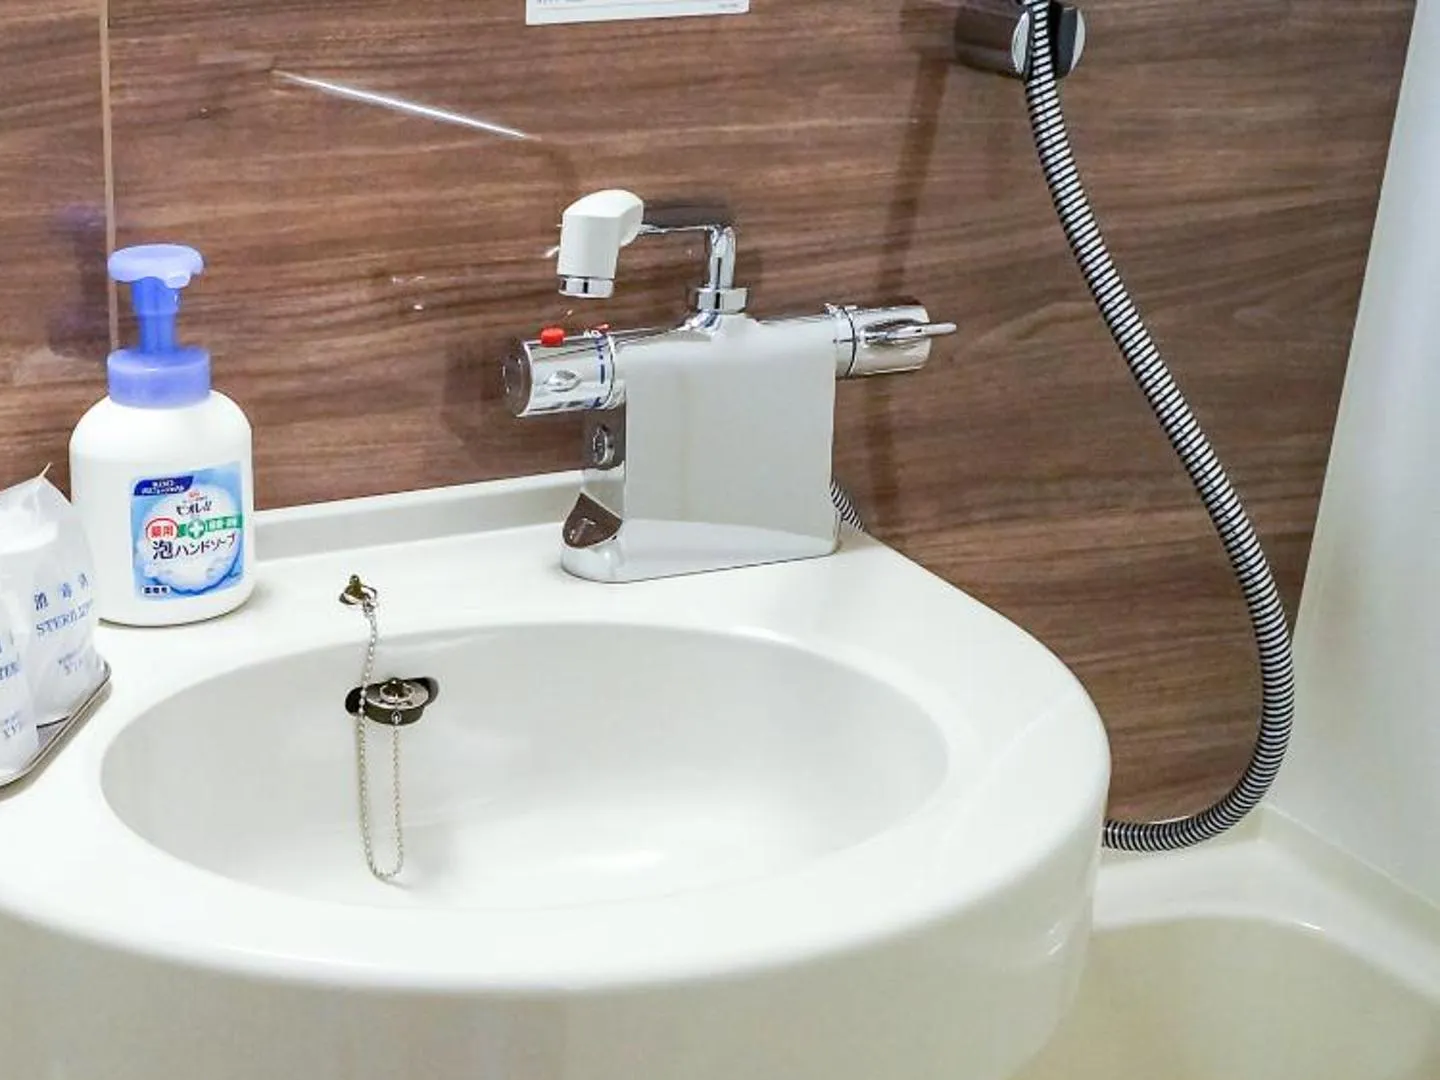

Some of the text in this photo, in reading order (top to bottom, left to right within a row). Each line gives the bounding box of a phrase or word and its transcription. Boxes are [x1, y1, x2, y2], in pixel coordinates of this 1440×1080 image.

[153, 533, 236, 560] 泡ハンドソープ
